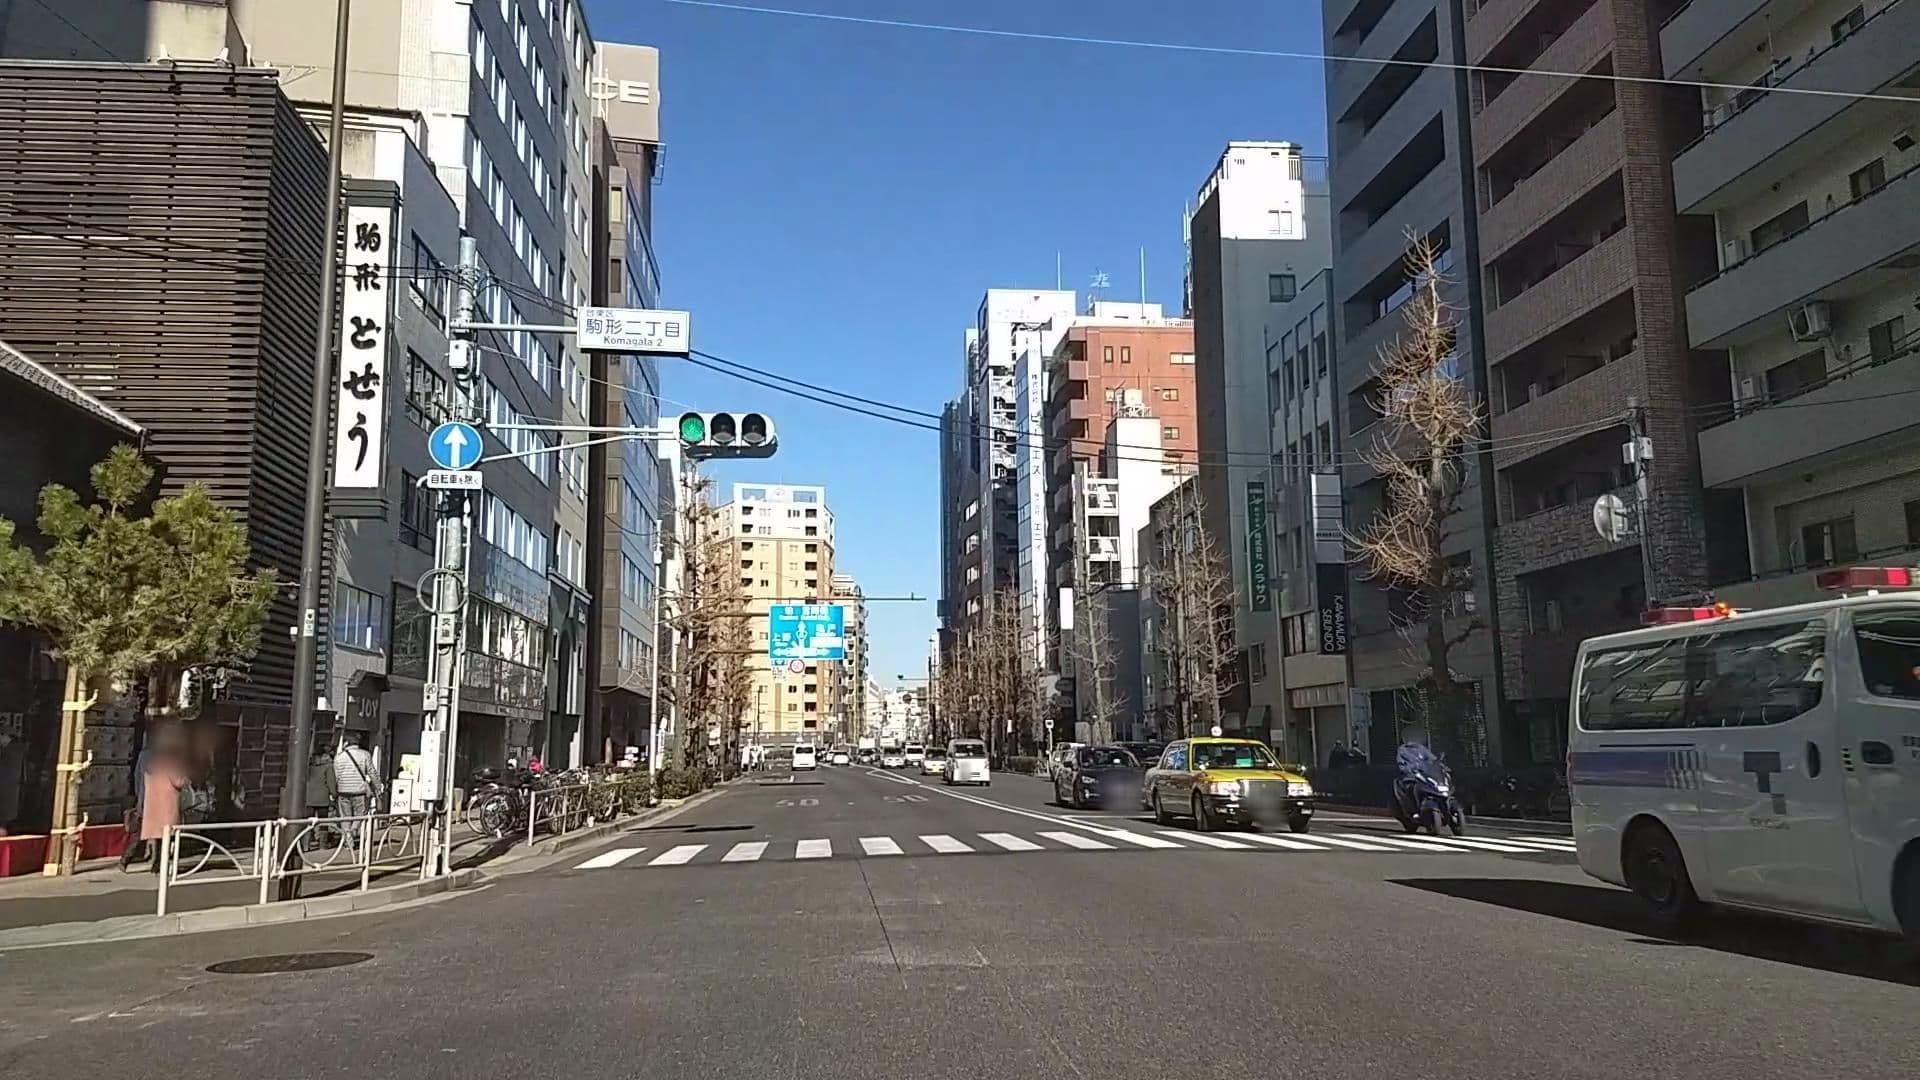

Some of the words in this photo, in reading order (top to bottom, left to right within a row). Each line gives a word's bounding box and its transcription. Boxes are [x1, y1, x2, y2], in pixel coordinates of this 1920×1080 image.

[586, 318, 680, 337] 駒形二丁目
[342, 222, 381, 472] 駒形どぜう
[656, 338, 663, 346] 2
[358, 698, 378, 718] JOY
